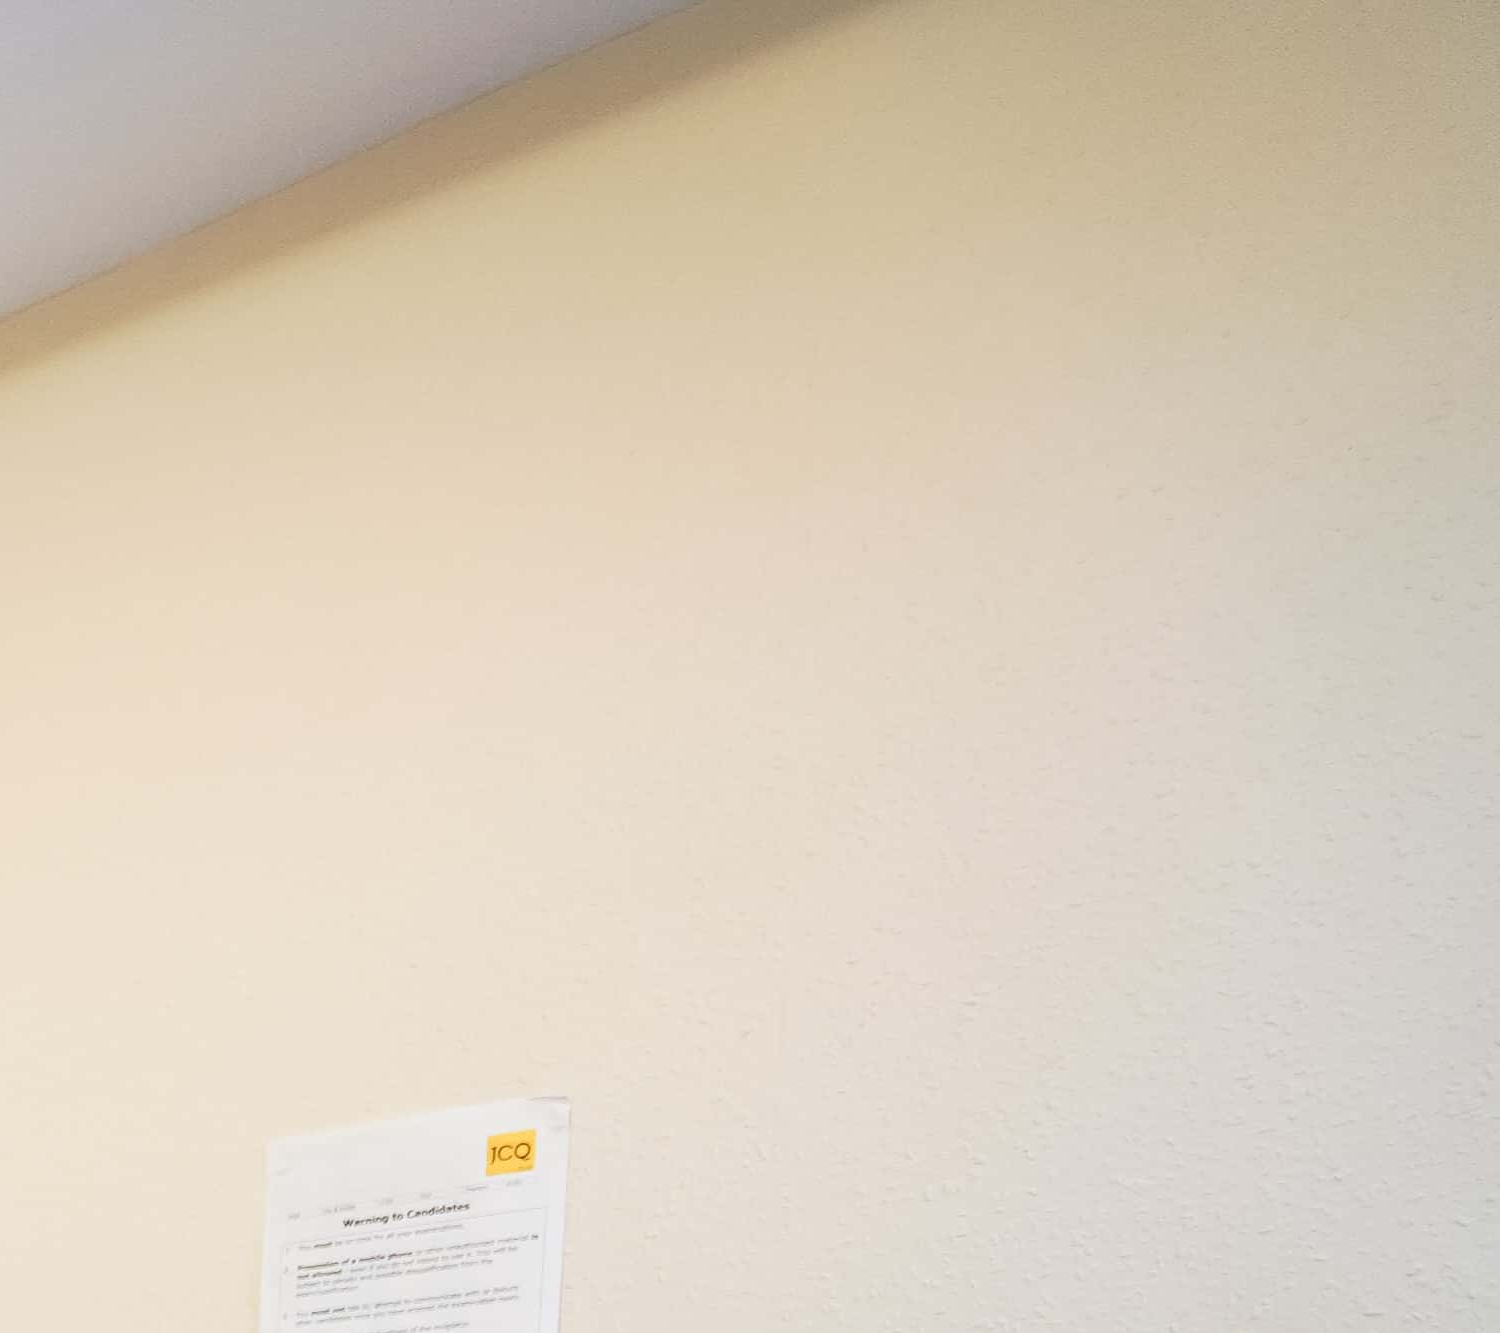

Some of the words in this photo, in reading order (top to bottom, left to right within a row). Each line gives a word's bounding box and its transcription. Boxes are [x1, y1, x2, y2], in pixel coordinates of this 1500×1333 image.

[490, 1141, 532, 1164] JCQ
[342, 1212, 389, 1228] Warning
[392, 1211, 403, 1222] to
[406, 1202, 470, 1220] Candidates
